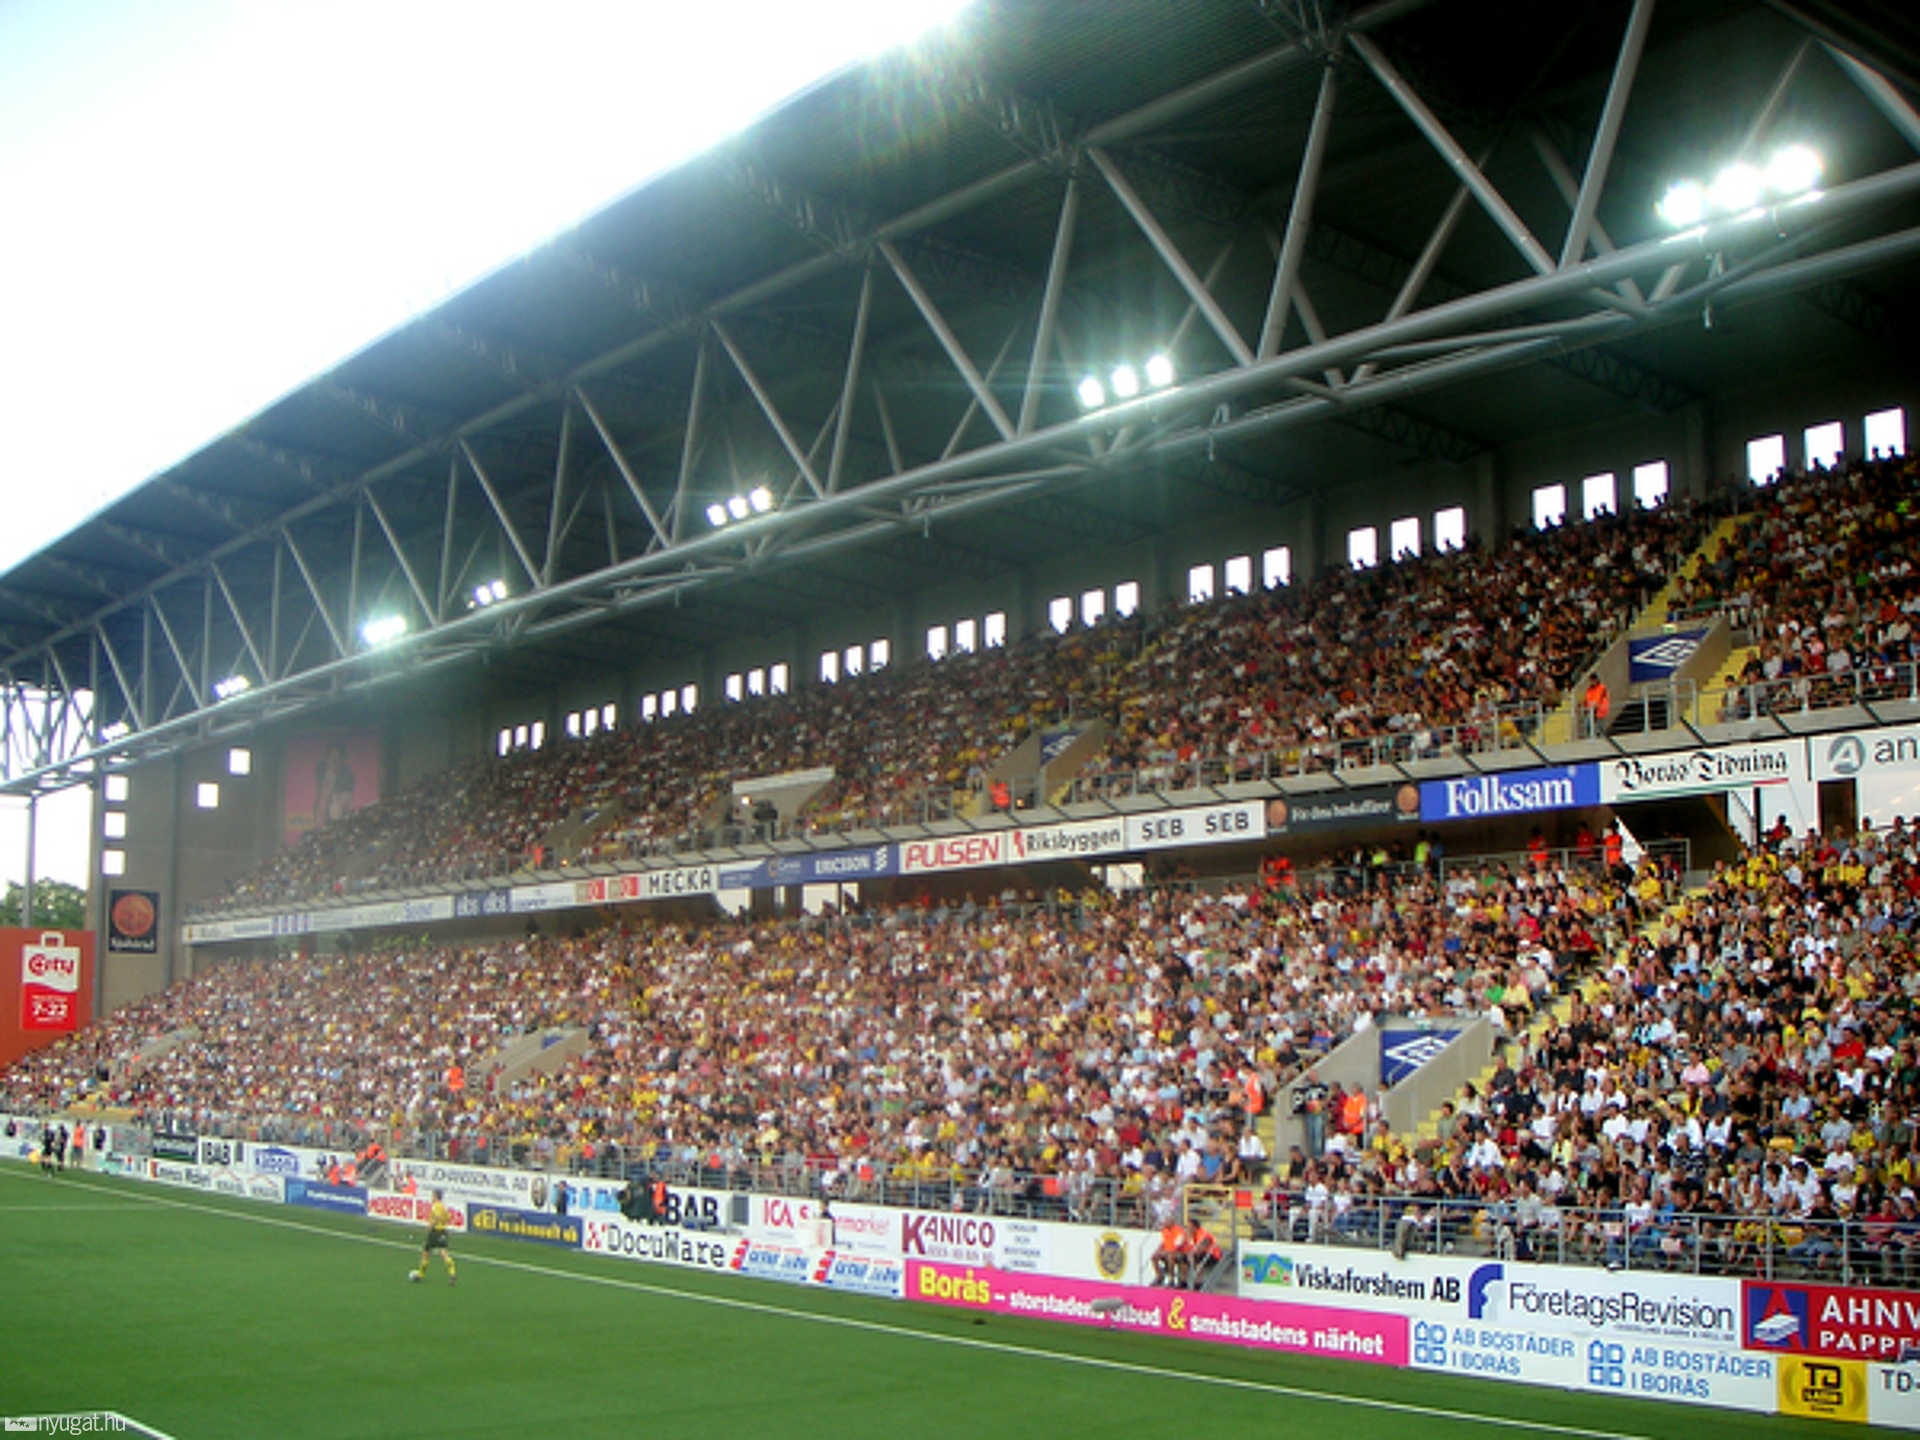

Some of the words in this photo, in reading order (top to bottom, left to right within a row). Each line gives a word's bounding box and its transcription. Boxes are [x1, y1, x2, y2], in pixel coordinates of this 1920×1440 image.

[1691, 749, 1788, 781] Tidning
[1446, 776, 1574, 816] Folksam
[1026, 826, 1121, 854] Riksbyggen
[1141, 818, 1185, 840] SEB
[1205, 811, 1250, 834] SEB
[904, 836, 1000, 870] PULSEN
[665, 1192, 719, 1228] BAB
[764, 1199, 794, 1228] ICA
[607, 1223, 725, 1267] DocuWare
[902, 1212, 996, 1255] KANICO
[1295, 1263, 1425, 1300] Viskaforshem
[1430, 1276, 1461, 1303] AB
[919, 1266, 990, 1305] Borås
[1167, 1297, 1186, 1329] &
[1189, 1314, 1307, 1346] småstadens
[1313, 1328, 1384, 1357] närhet
[1509, 1282, 1734, 1332] FöretagsRevision
[1451, 1328, 1476, 1346] AB
[1480, 1329, 1575, 1358] BOSTÄDER
[1461, 1350, 1521, 1376] BORÅS
[1631, 1347, 1659, 1366] AB
[1663, 1348, 1771, 1379] BOSTÄDER
[1640, 1370, 1710, 1398] BORÅS
